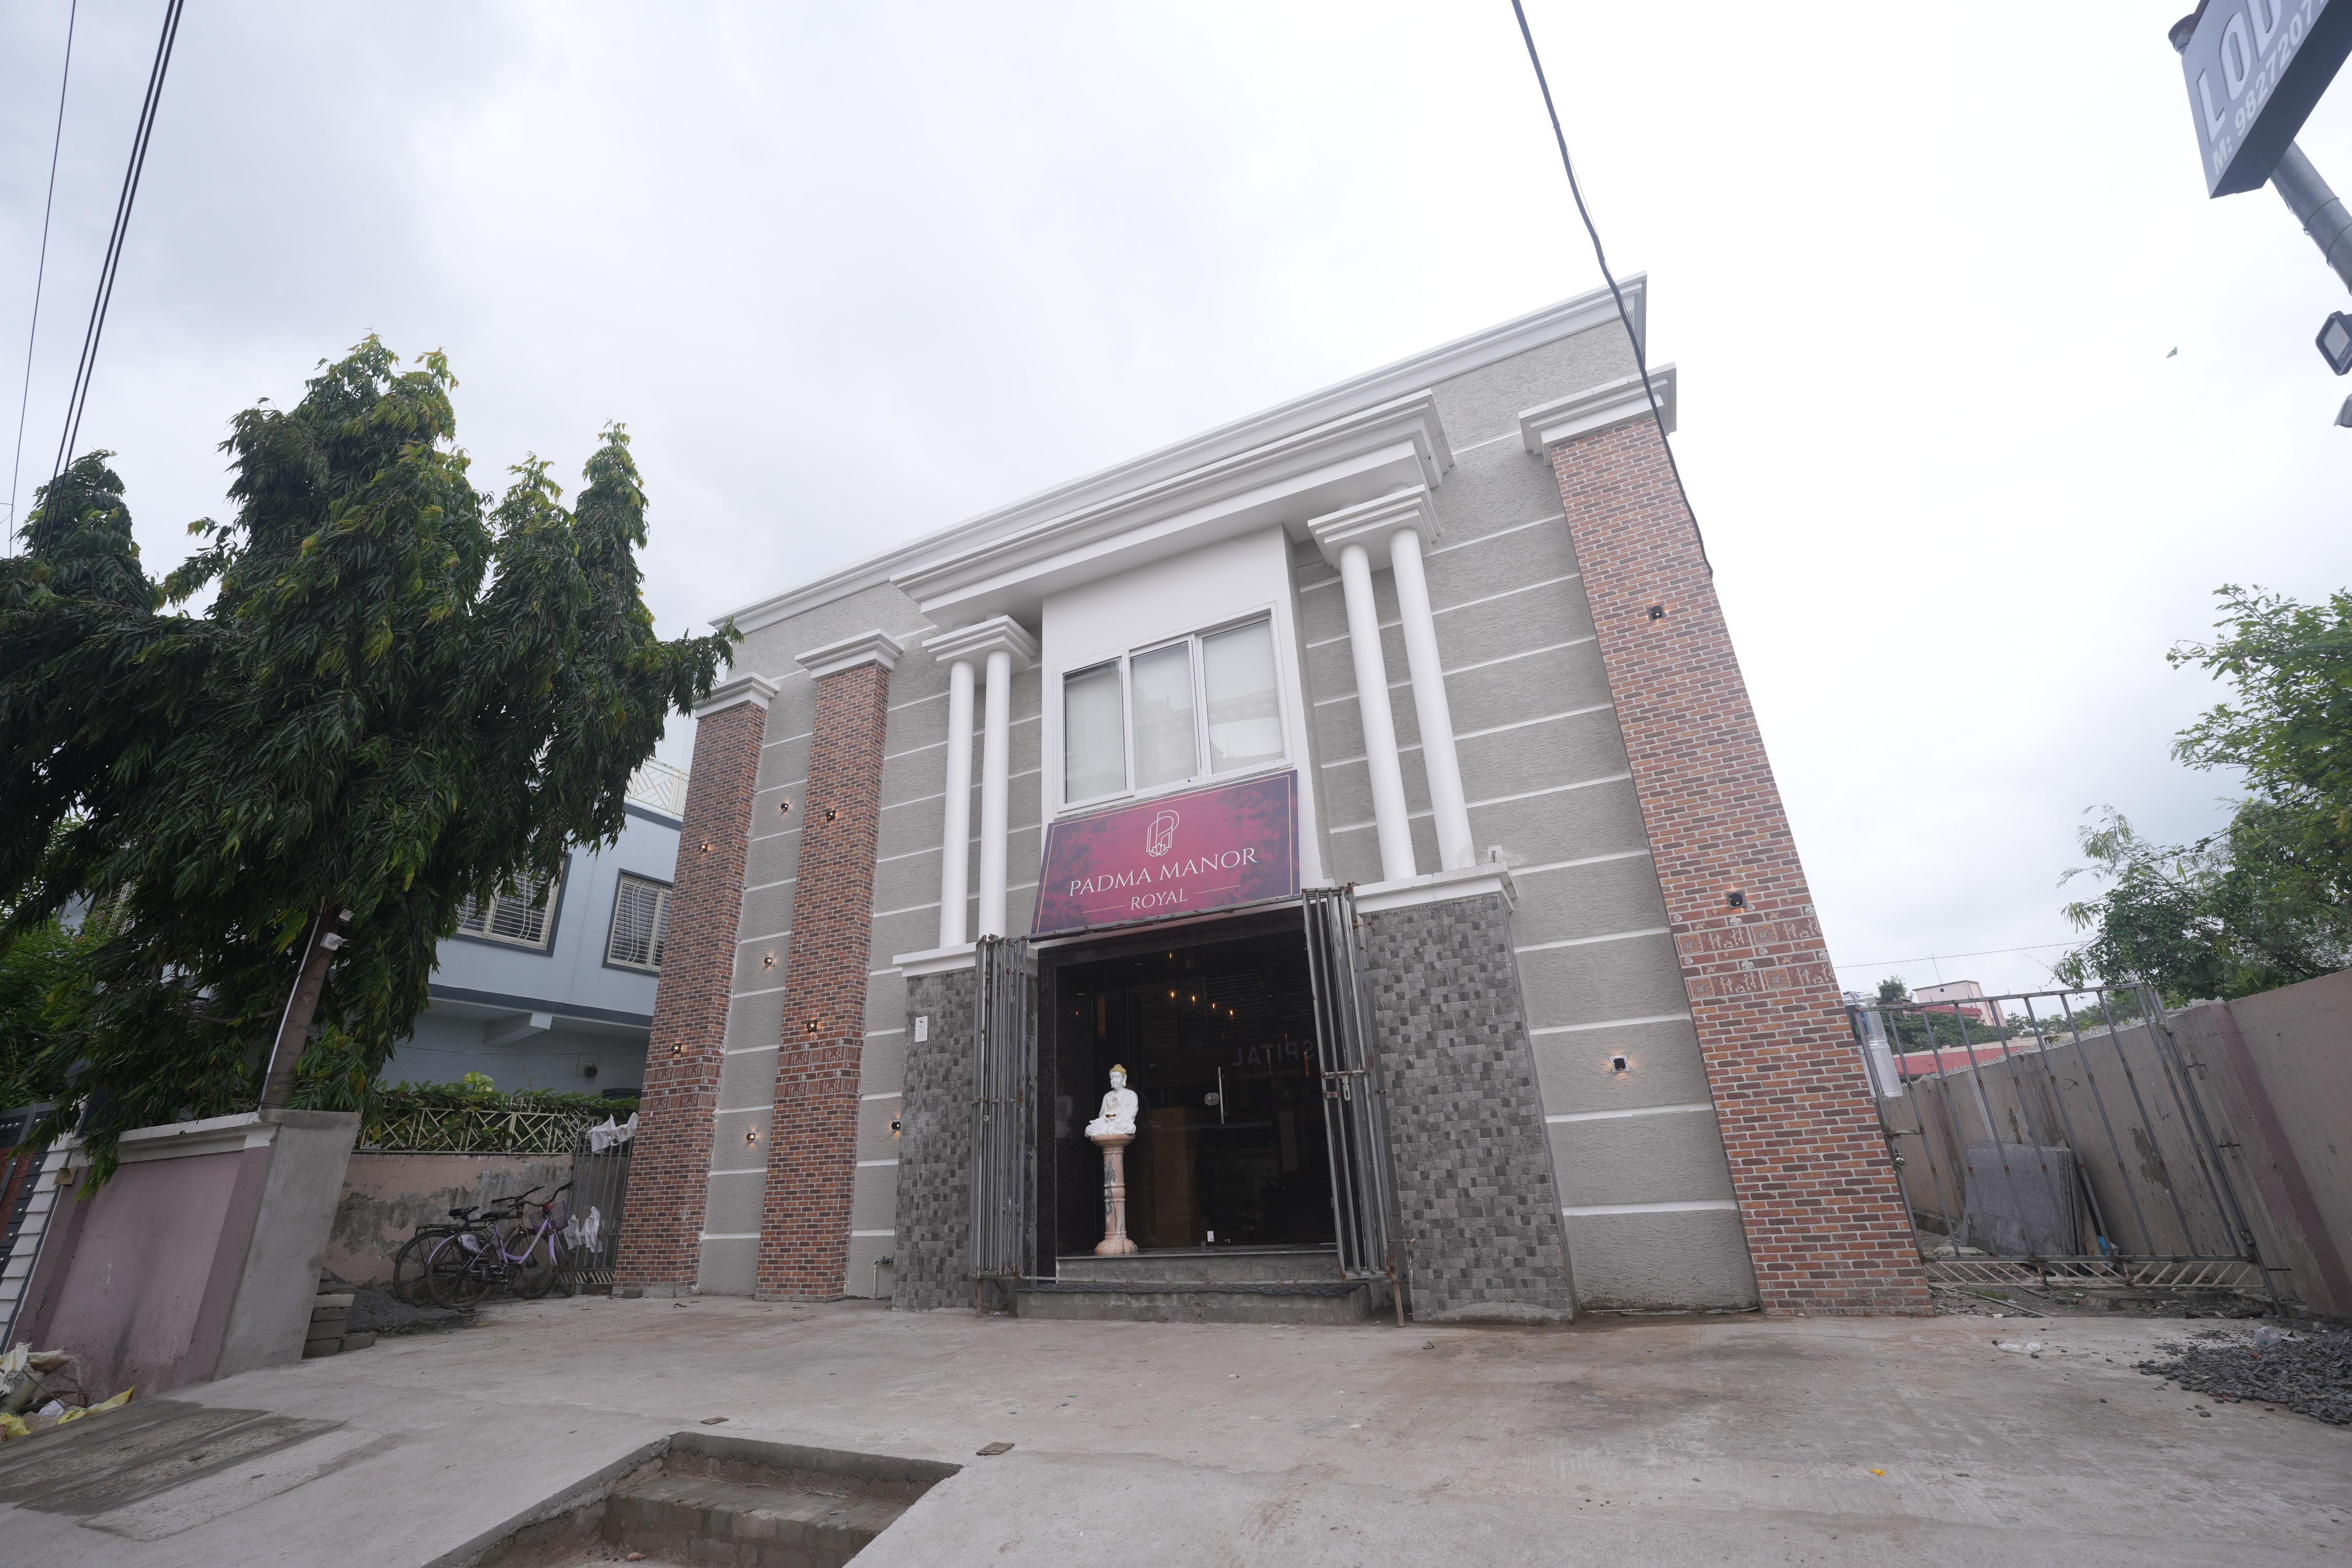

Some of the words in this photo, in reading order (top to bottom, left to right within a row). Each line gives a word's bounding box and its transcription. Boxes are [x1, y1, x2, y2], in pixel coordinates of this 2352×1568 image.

[2212, 135, 2232, 176] M:
[2235, 0, 2324, 136] 9827207
[1069, 868, 1152, 896] PADMA
[1159, 848, 1259, 881] MANOR
[1131, 889, 1187, 910] ROYAL
